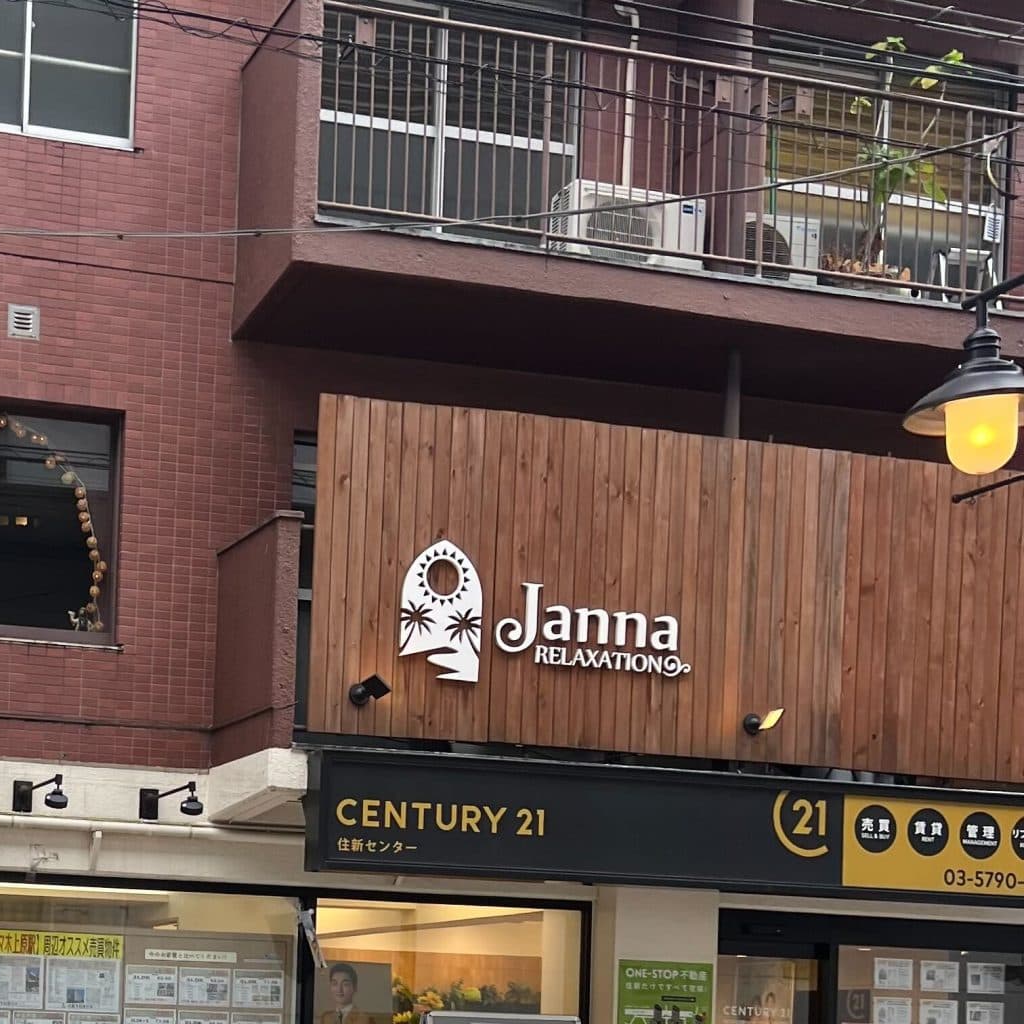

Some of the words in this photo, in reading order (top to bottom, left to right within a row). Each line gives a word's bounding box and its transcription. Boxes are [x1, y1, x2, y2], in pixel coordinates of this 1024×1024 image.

[495, 582, 679, 653] Janna
[534, 645, 664, 676] RELAXATION
[336, 798, 507, 834] CENTURY
[516, 808, 546, 836] 21
[861, 818, 890, 832] 売買
[915, 821, 943, 836] 賃貸
[966, 825, 995, 839] 管理
[337, 837, 417, 854] 住新センター
